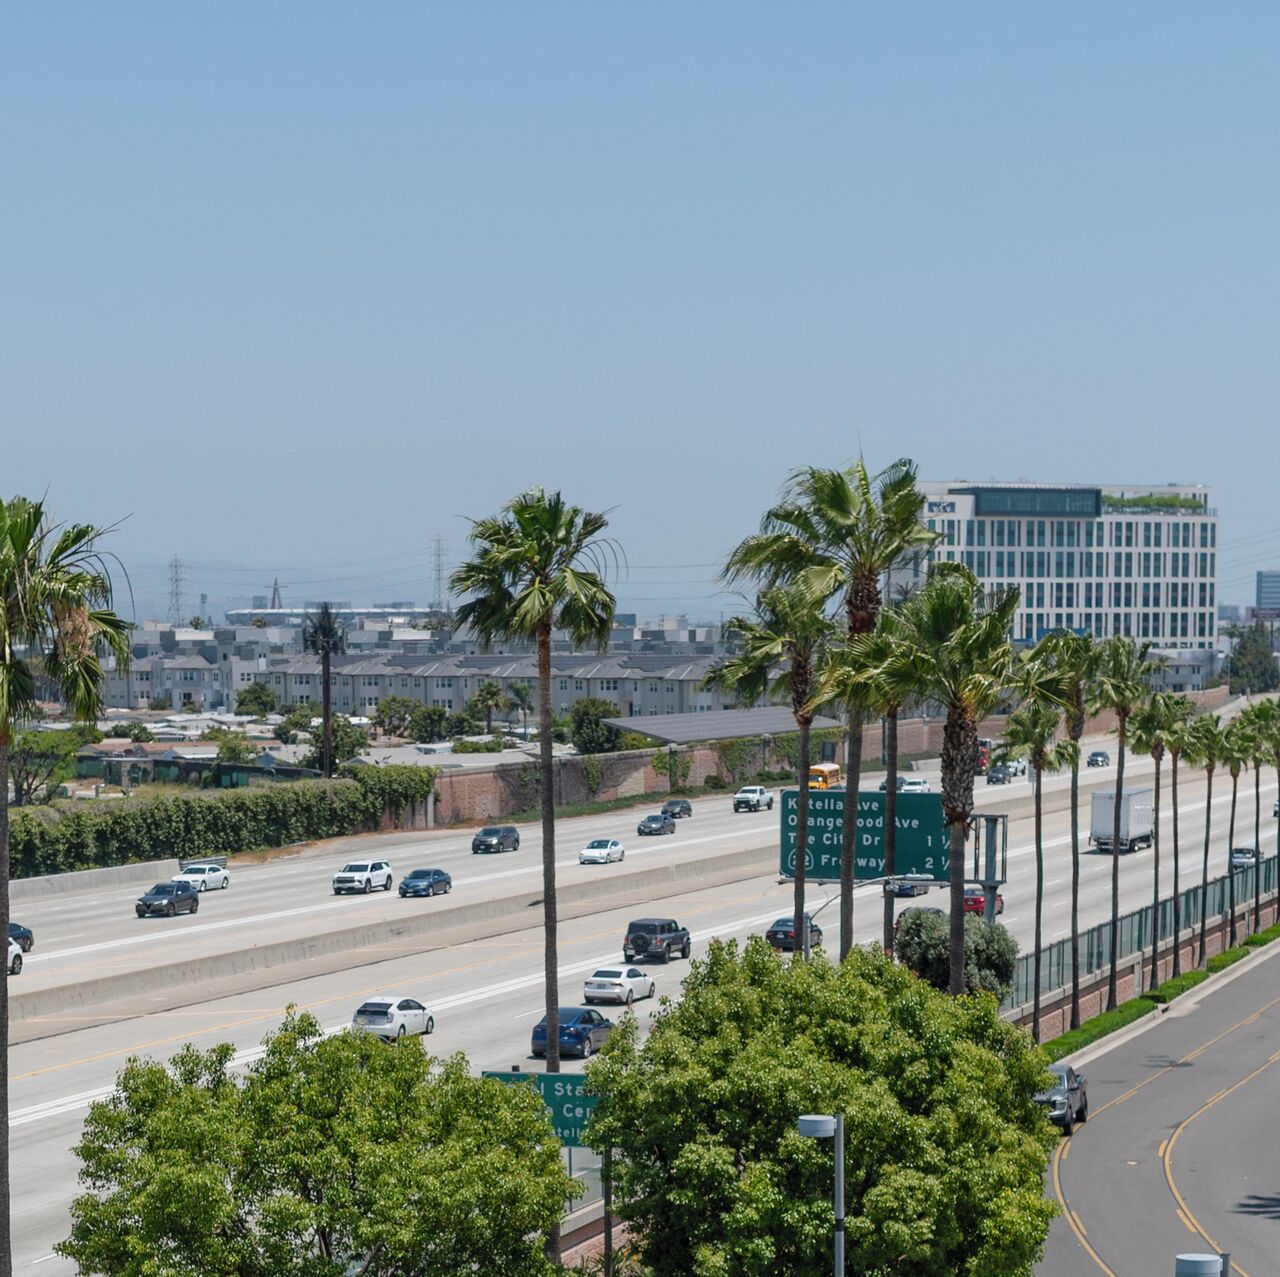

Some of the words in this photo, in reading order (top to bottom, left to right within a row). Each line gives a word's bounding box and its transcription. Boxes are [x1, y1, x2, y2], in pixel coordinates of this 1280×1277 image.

[788, 798, 844, 810] Ktella
[788, 814, 883, 830] Oangeood
[787, 832, 816, 844] Te
[822, 833, 844, 845] Cit
[862, 834, 881, 846] Dr
[821, 855, 886, 871] Frway
[925, 857, 934, 869] 2
